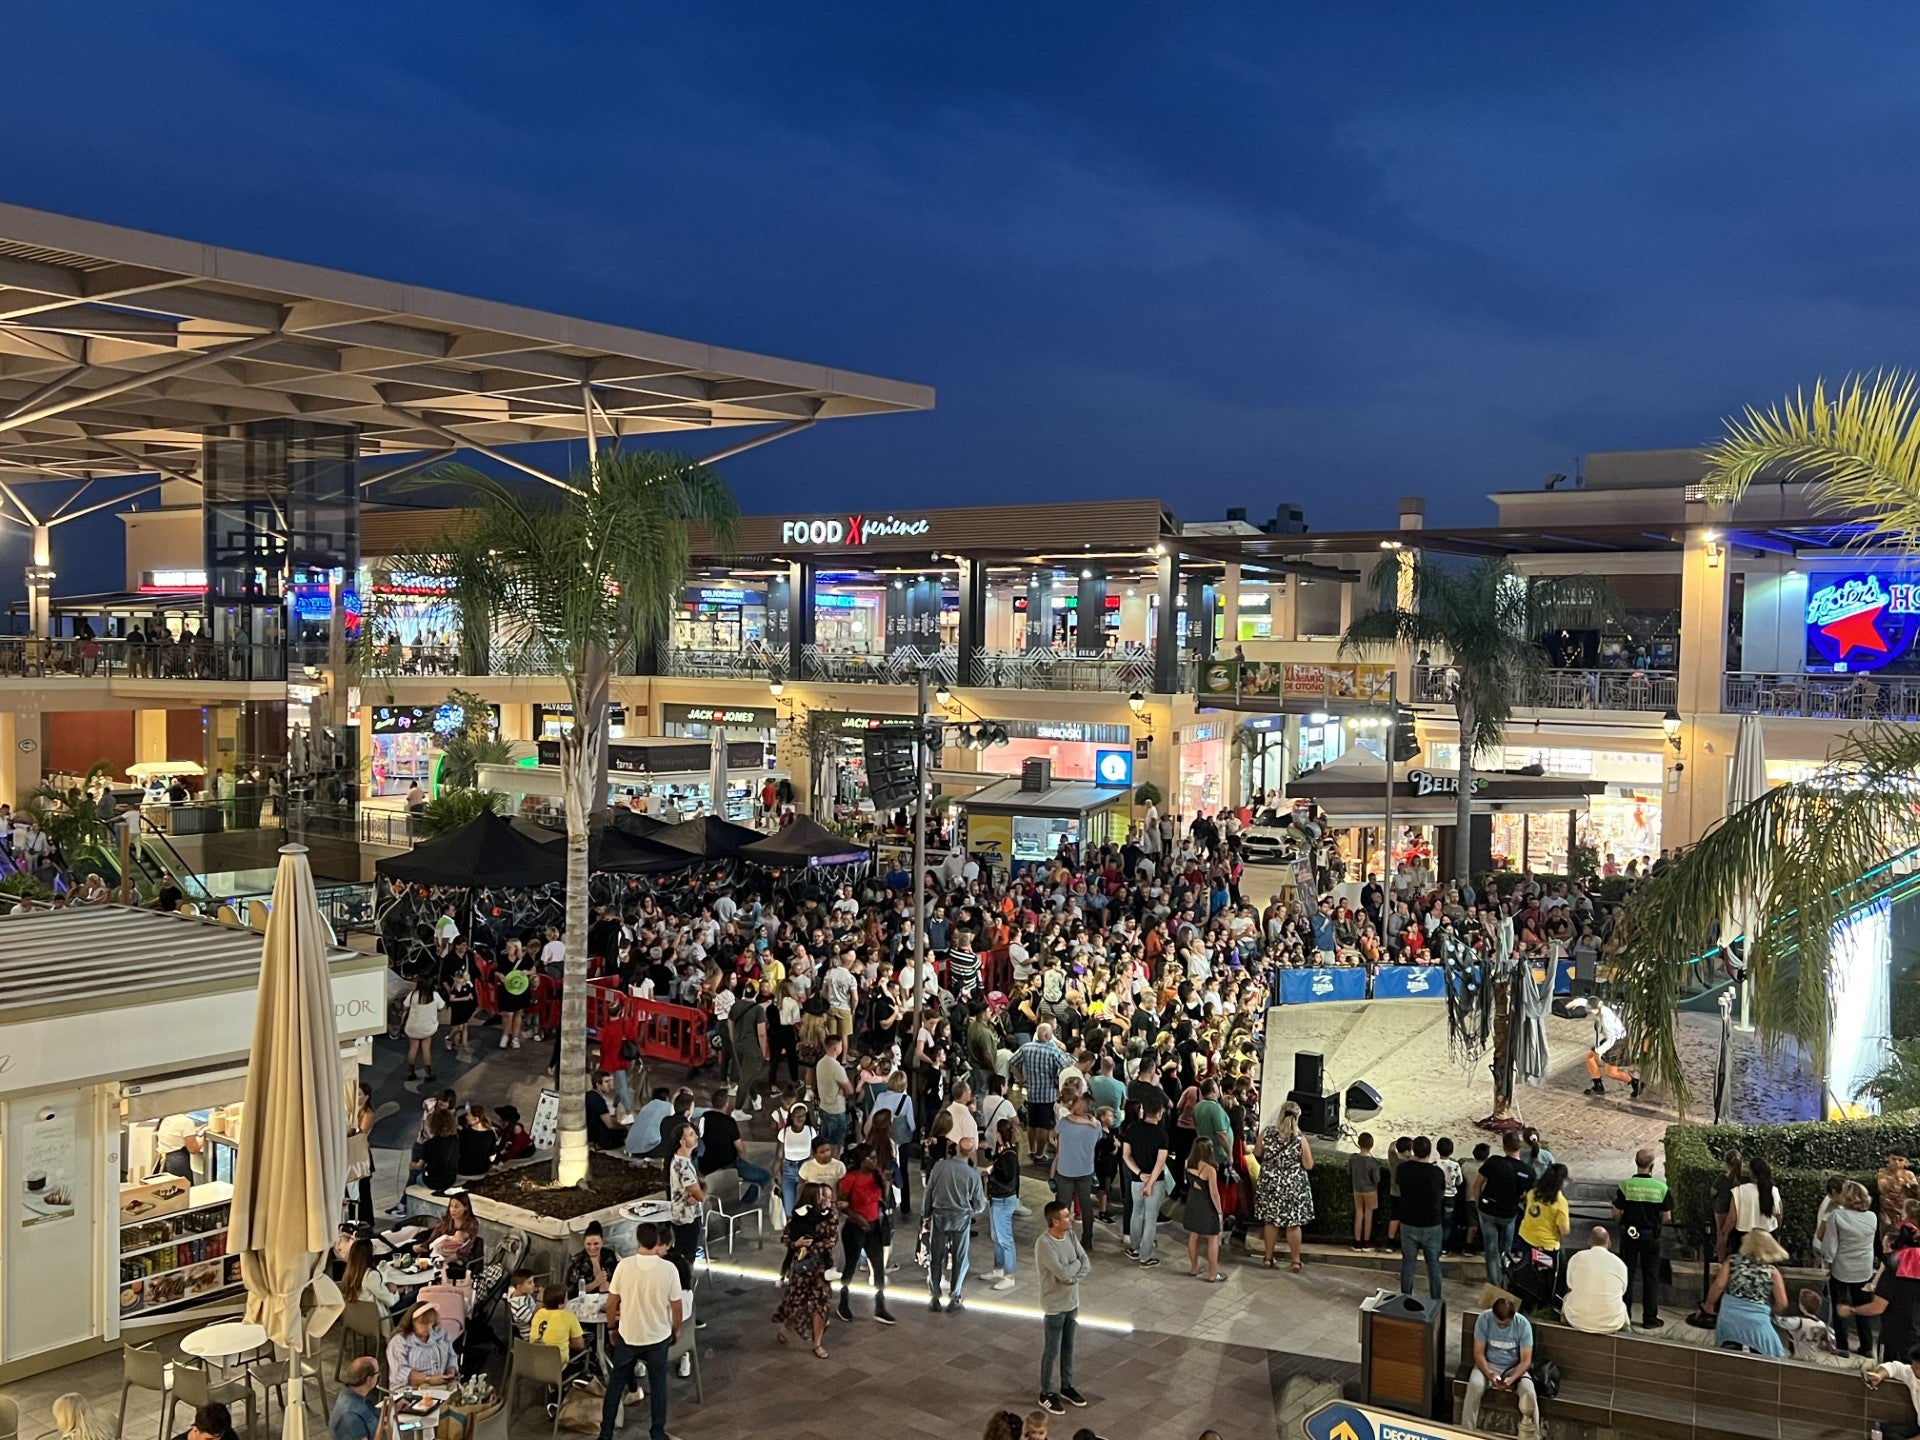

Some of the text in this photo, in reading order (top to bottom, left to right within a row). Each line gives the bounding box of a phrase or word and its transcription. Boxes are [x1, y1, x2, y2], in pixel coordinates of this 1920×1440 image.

[783, 514, 930, 545] FOOD Xperience
[686, 709, 712, 720] JACK
[722, 711, 754, 722] JONES
[841, 717, 869, 728] JACK
[1409, 770, 1478, 796] BELRS
